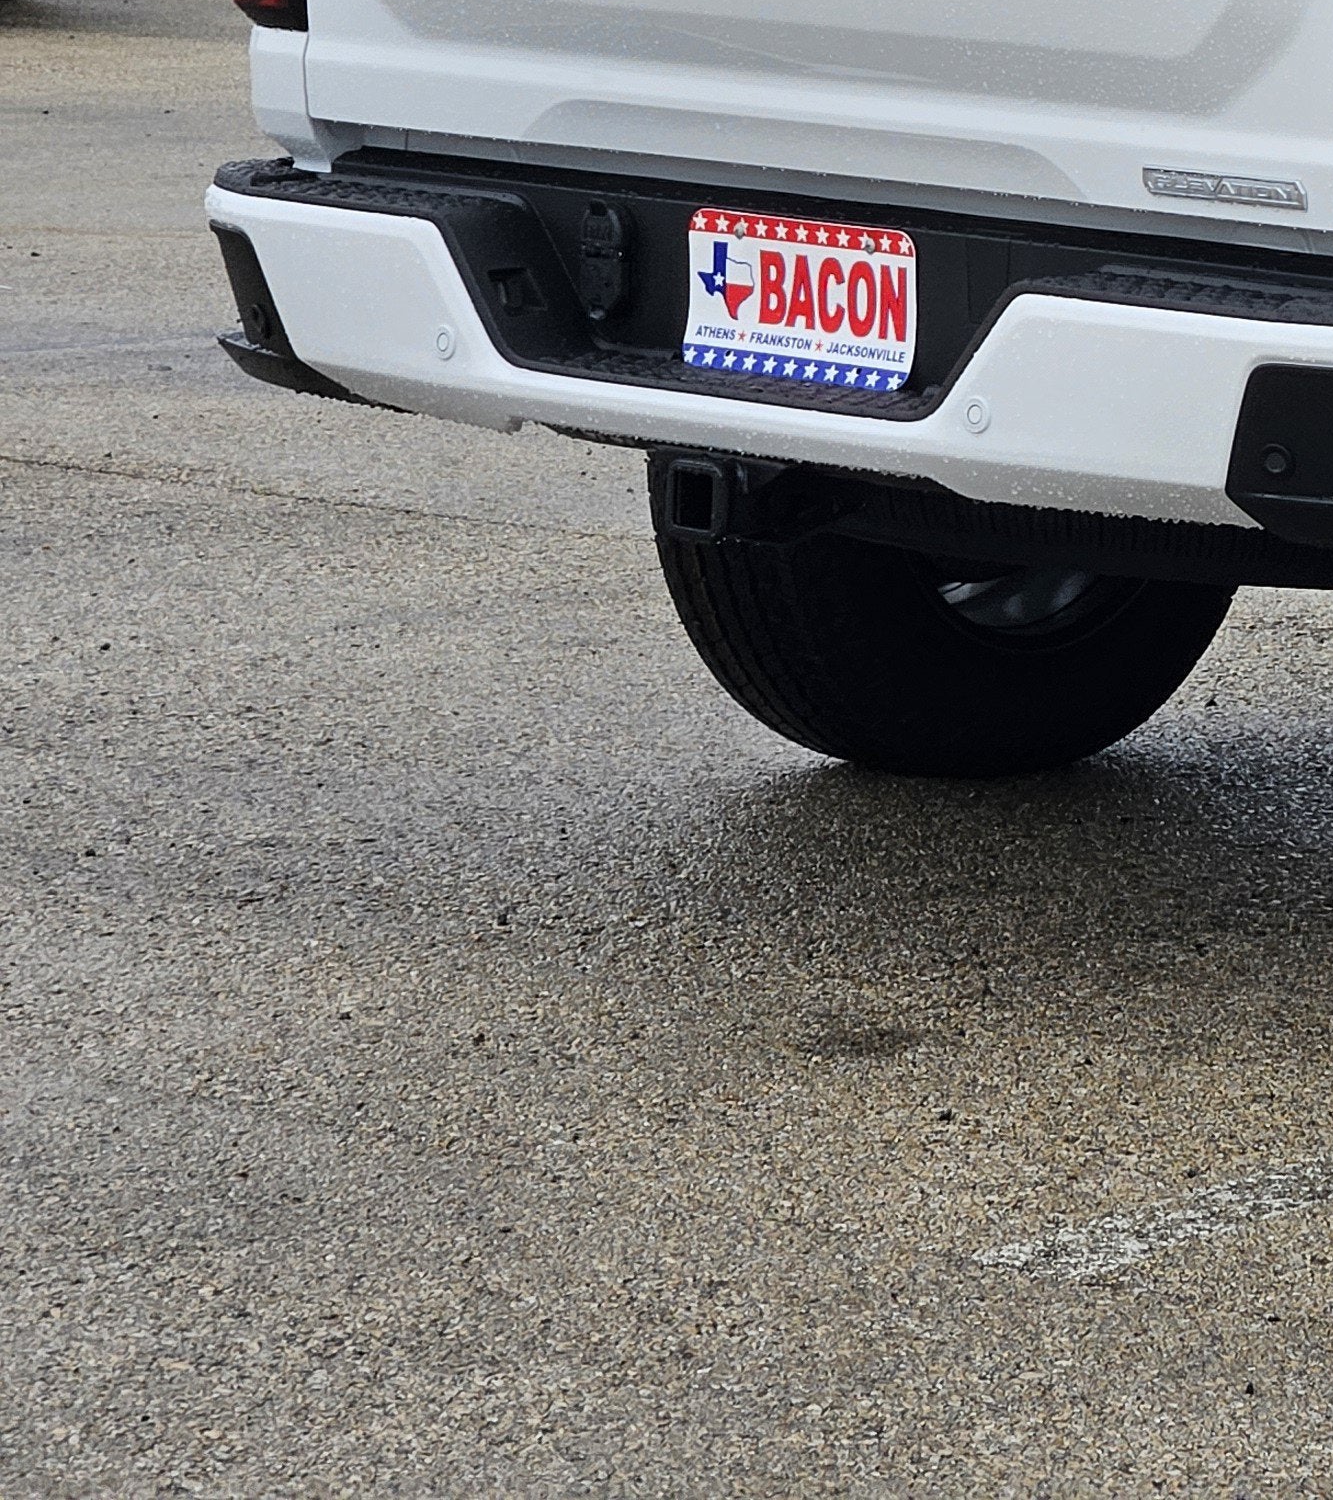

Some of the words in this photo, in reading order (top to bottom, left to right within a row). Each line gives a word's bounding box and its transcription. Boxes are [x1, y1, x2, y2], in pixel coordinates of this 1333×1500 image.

[759, 250, 907, 342] BACON
[695, 325, 737, 341] ATHENS
[749, 331, 813, 351] FRANKSTON
[826, 341, 906, 363] JACKSONVILLE
